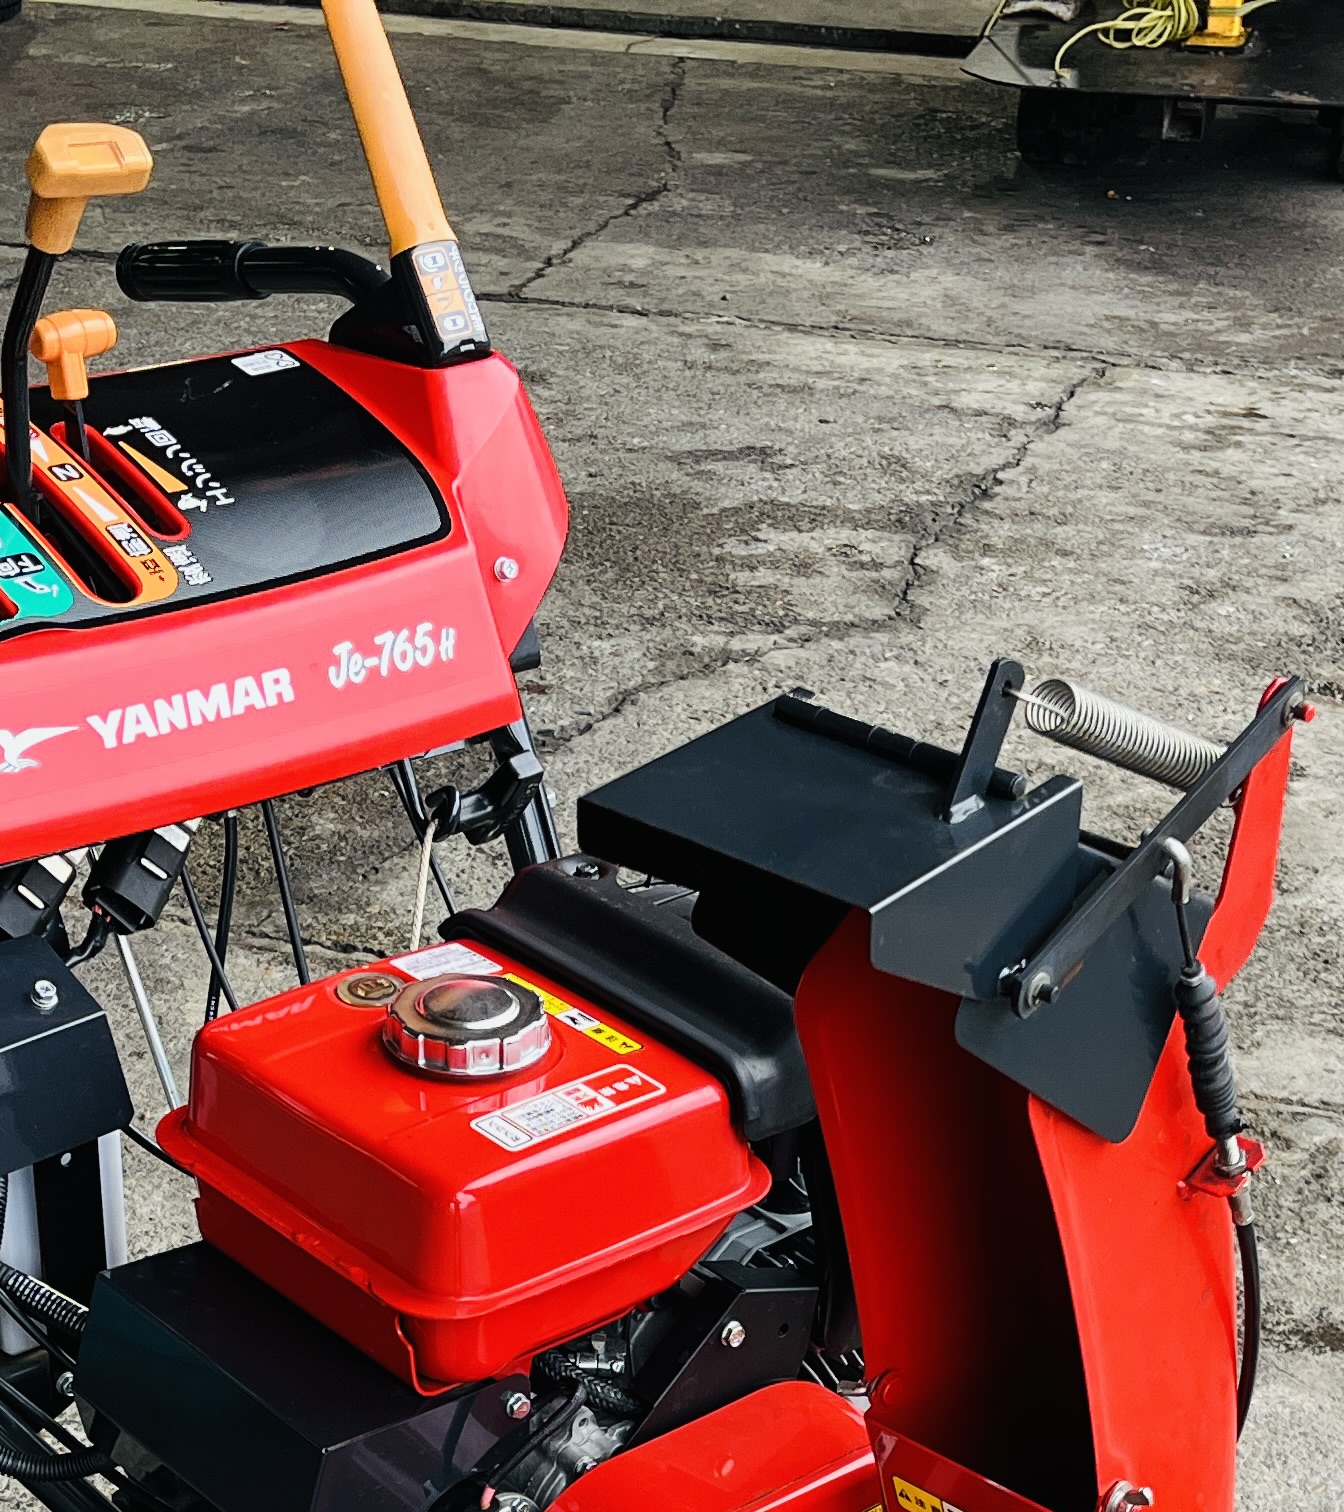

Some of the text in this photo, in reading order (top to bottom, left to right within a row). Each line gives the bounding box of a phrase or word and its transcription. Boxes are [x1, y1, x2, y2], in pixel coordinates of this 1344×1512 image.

[50, 465, 80, 480] N
[127, 415, 236, 507] エンジン回転
[86, 667, 295, 749] YANMAR
